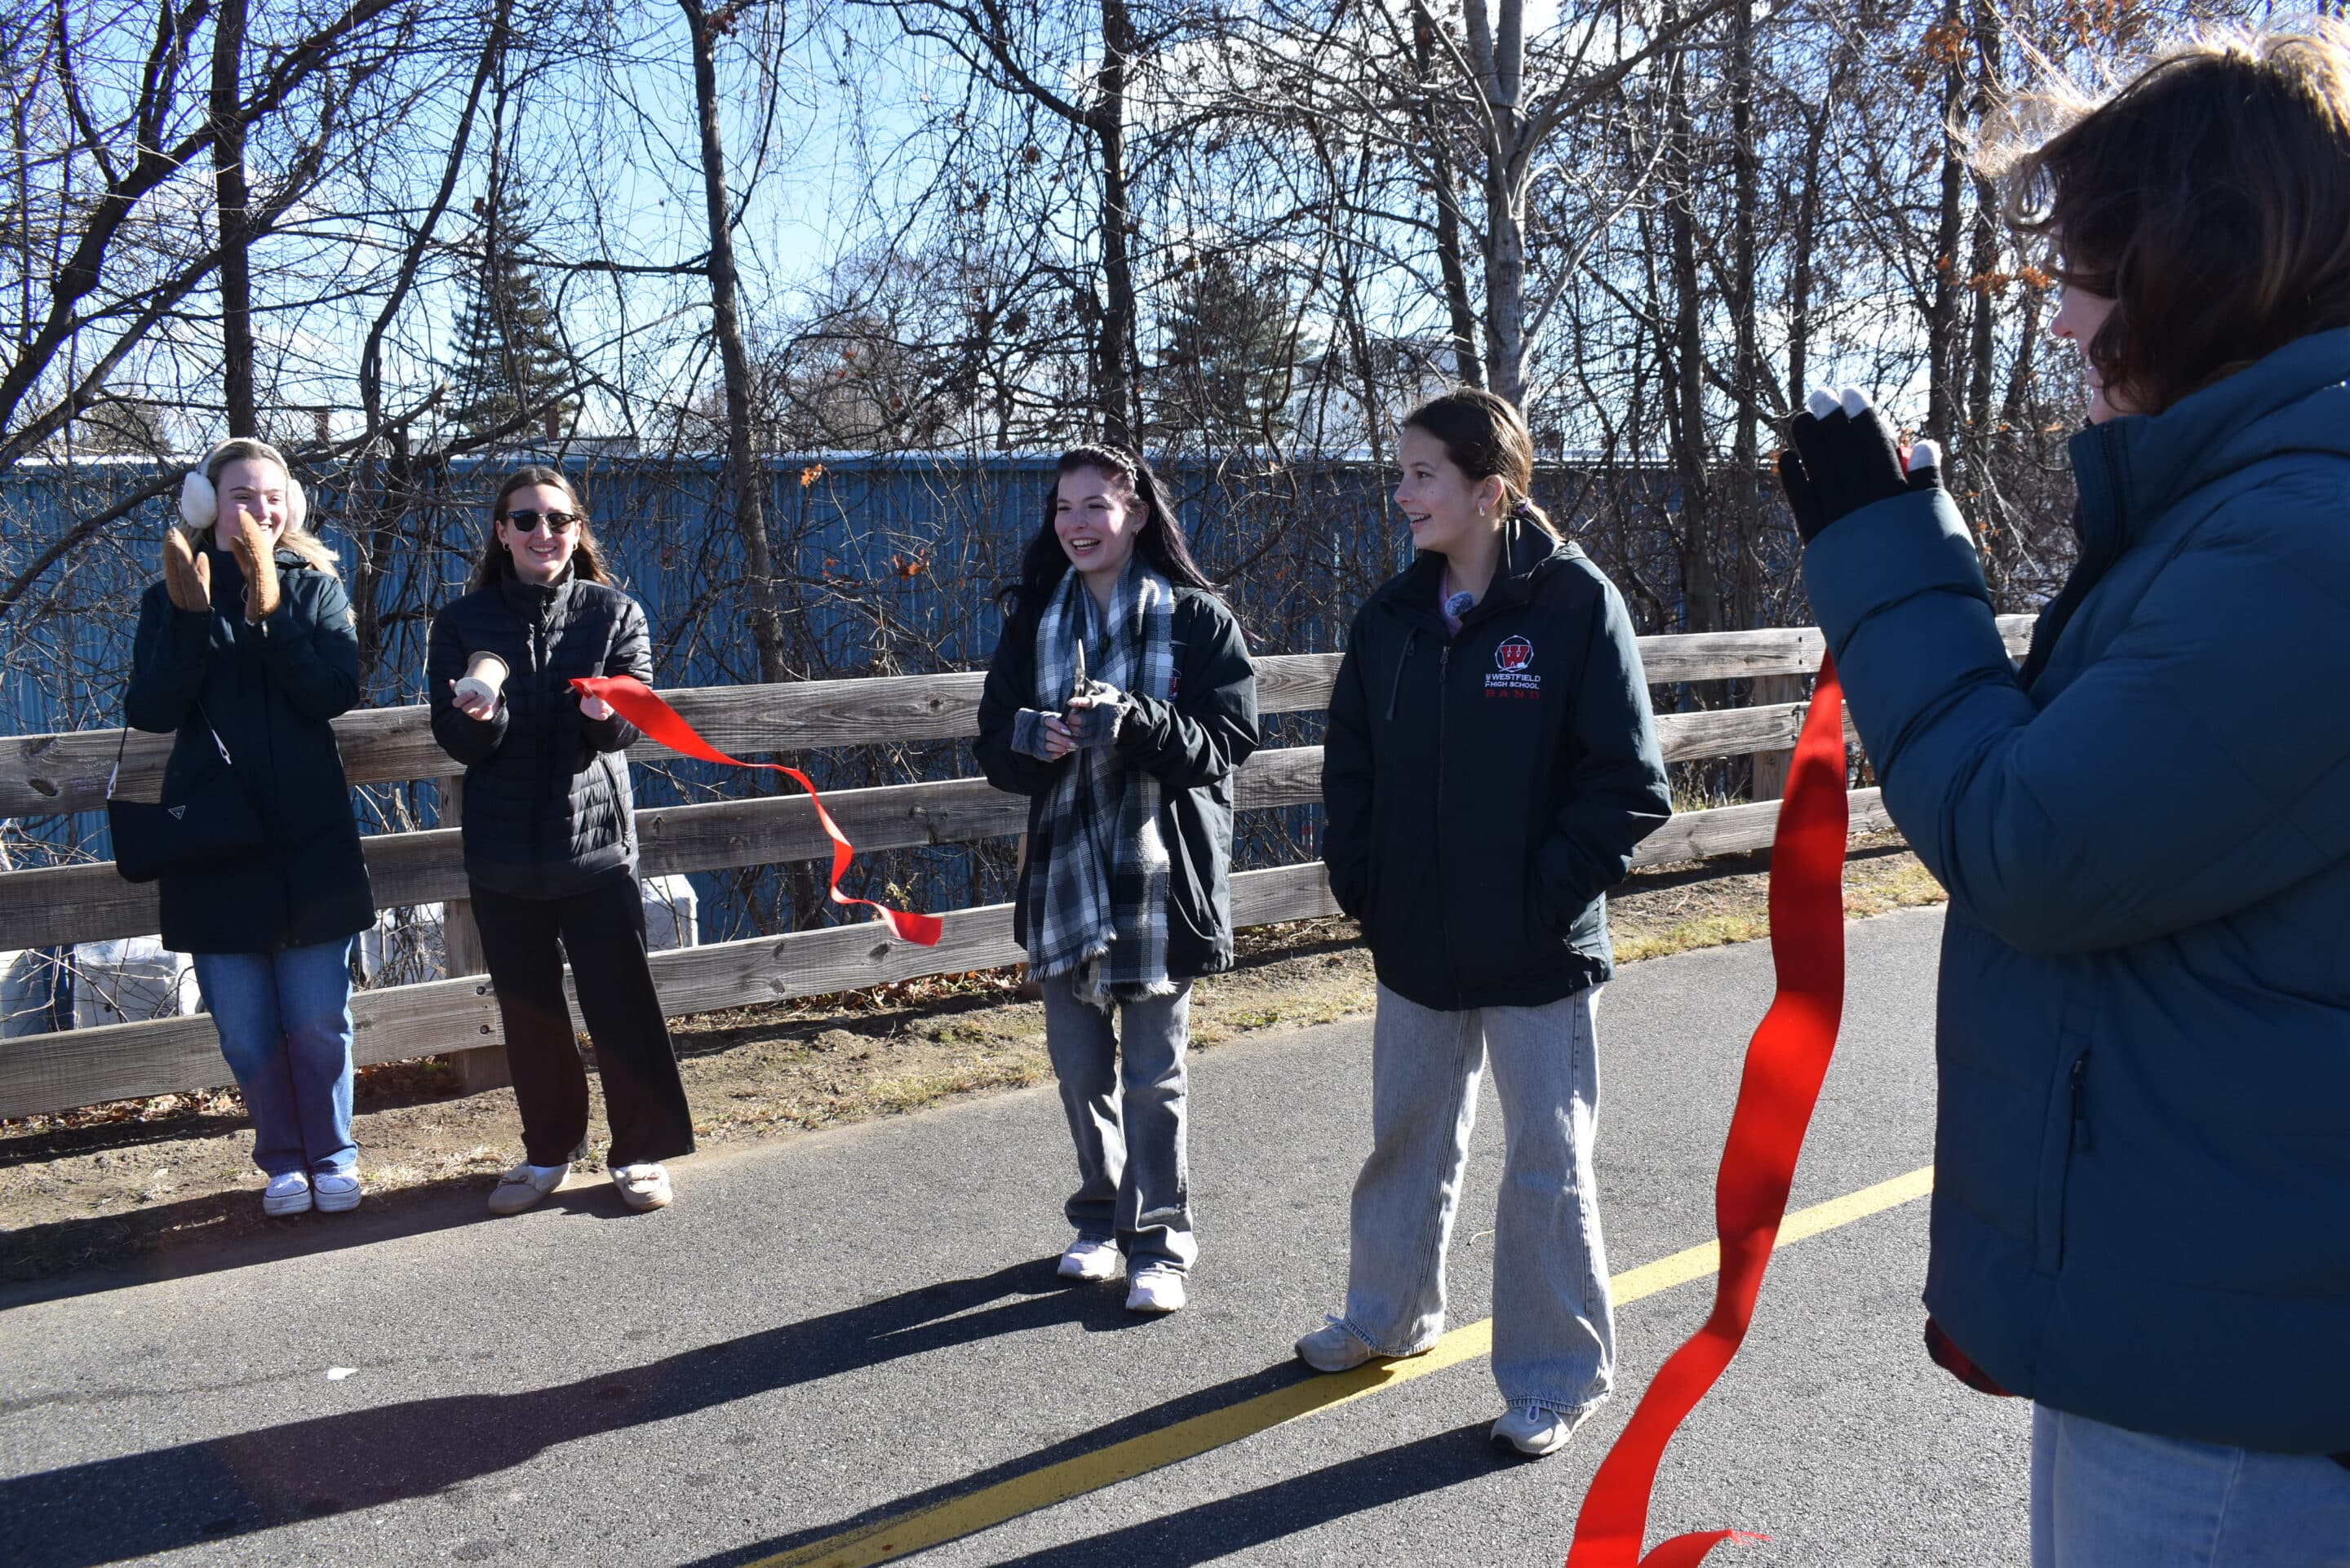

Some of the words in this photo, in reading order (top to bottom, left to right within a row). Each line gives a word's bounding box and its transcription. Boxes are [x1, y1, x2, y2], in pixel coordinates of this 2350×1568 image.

[1500, 644, 1530, 668] W
[1492, 674, 1541, 682] WESTFIELD
[1510, 681, 1540, 689] SCHOOL
[1485, 689, 1540, 699] BAND
